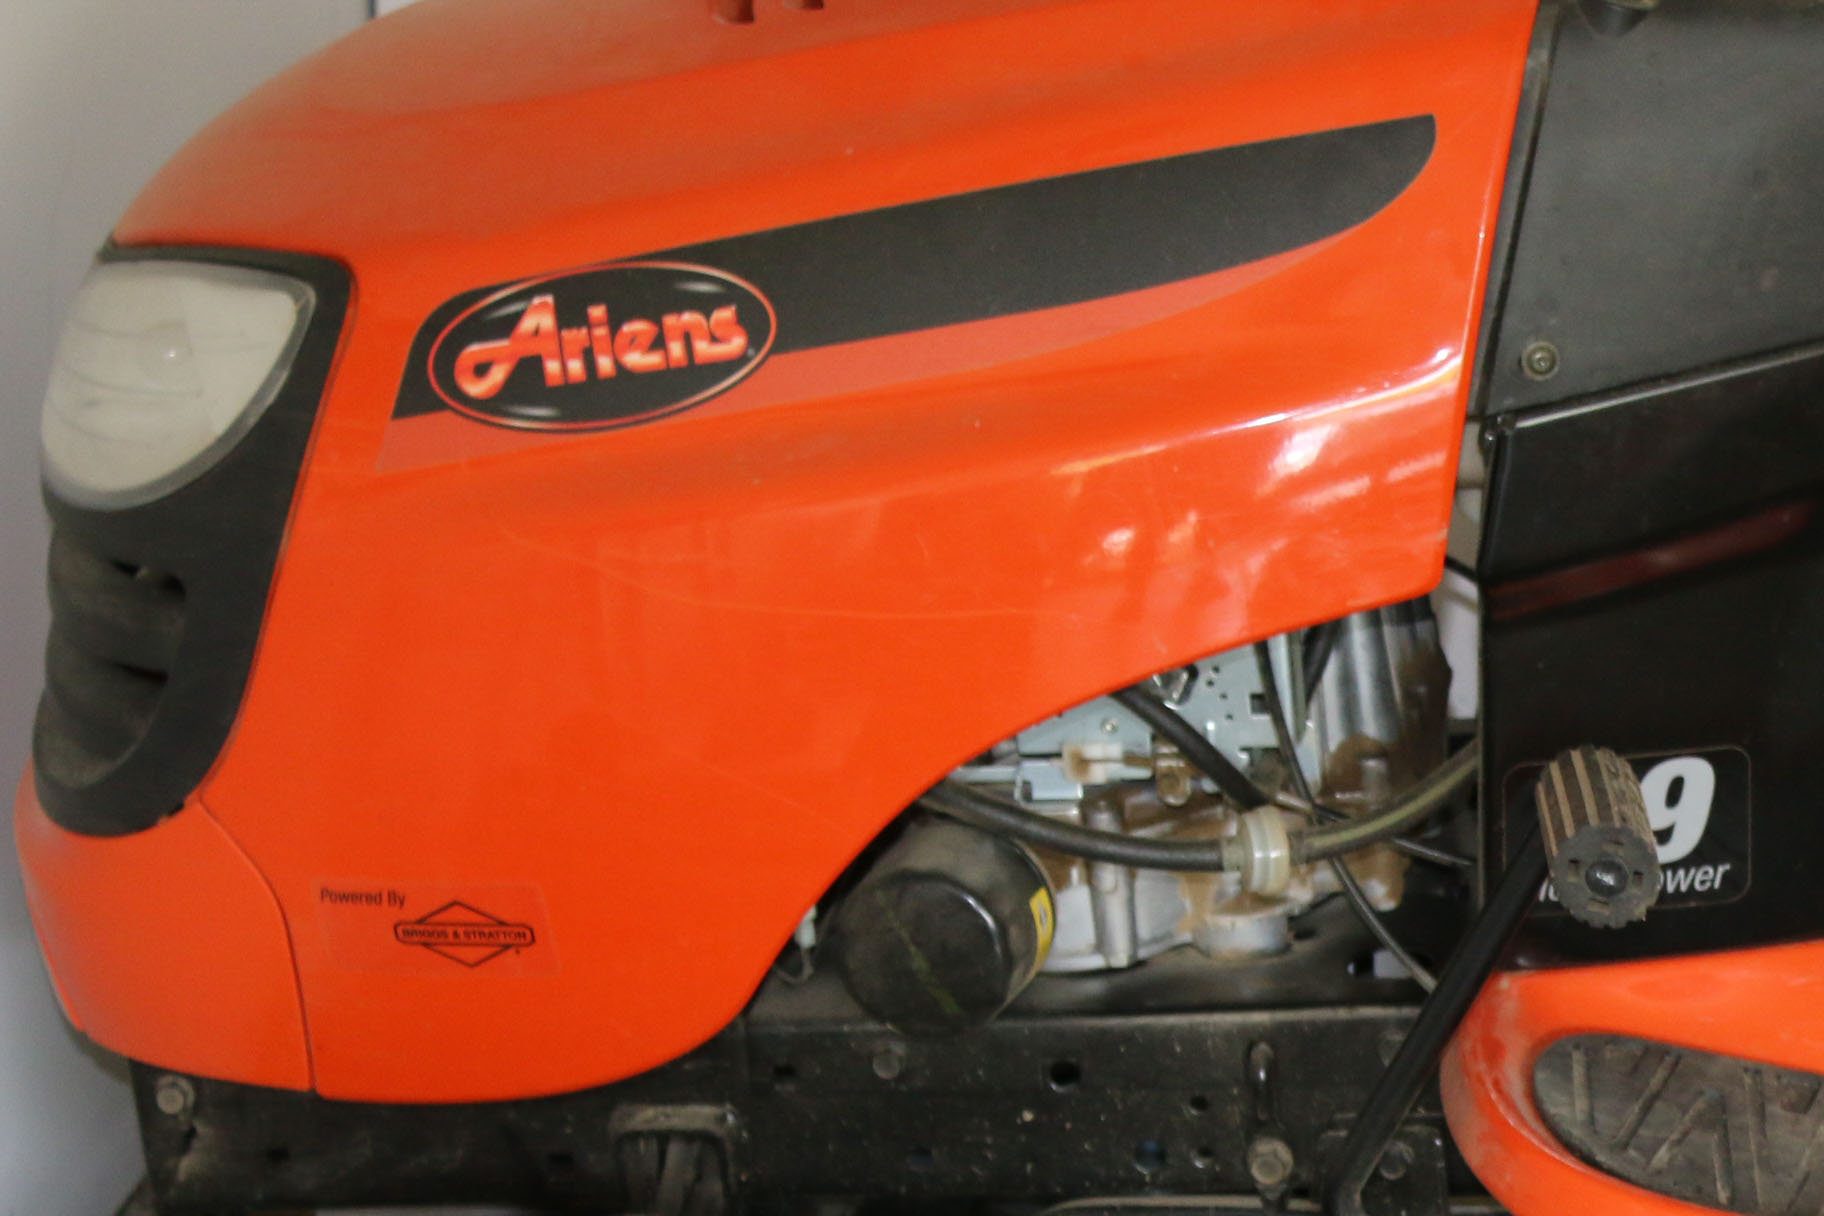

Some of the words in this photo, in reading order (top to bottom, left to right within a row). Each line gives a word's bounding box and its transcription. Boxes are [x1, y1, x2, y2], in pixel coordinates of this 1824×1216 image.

[453, 294, 748, 400] Ariens
[320, 886, 383, 907] Powered
[386, 889, 406, 909] By
[463, 929, 527, 941] STRATTON
